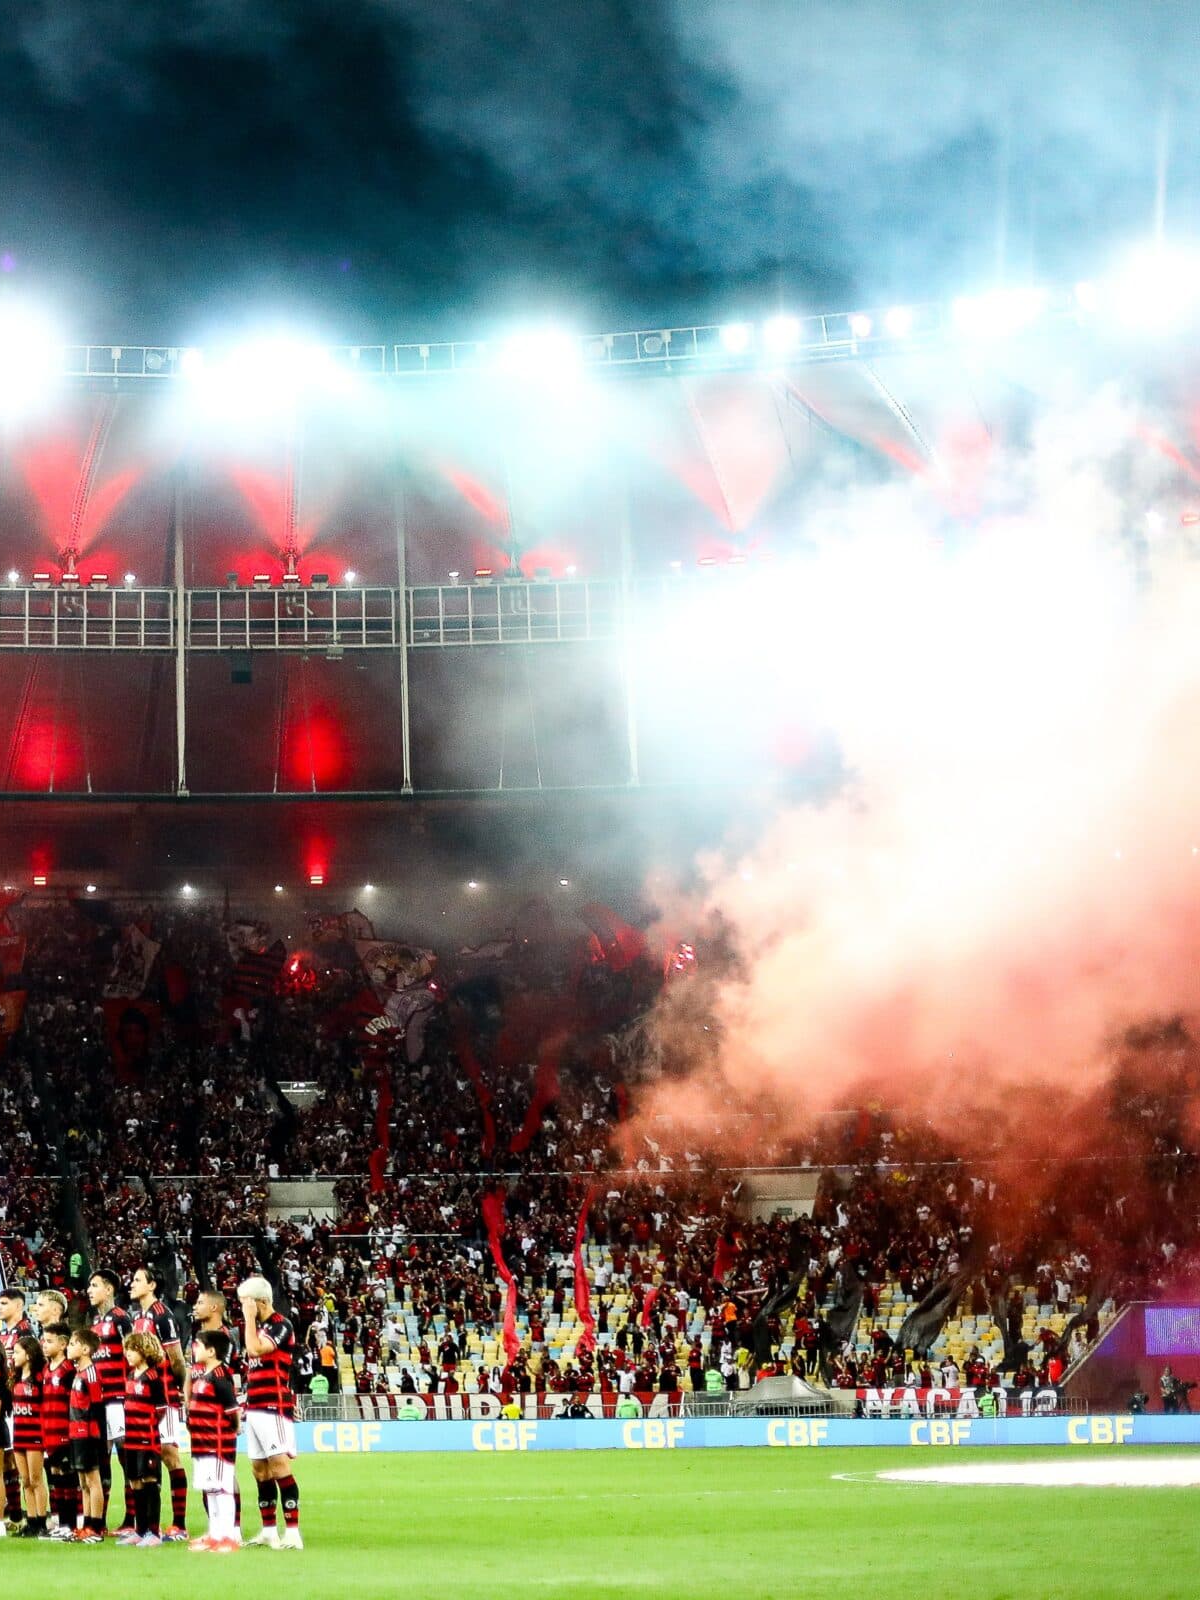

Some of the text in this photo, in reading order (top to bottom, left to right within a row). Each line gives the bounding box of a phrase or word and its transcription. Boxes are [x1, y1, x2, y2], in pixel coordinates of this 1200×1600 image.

[313, 1423, 382, 1452] CBF
[473, 1422, 538, 1451] CBF
[623, 1421, 685, 1449] CBF
[767, 1420, 829, 1447] CBF
[910, 1420, 972, 1446] CBF
[1067, 1416, 1135, 1445] CBF
